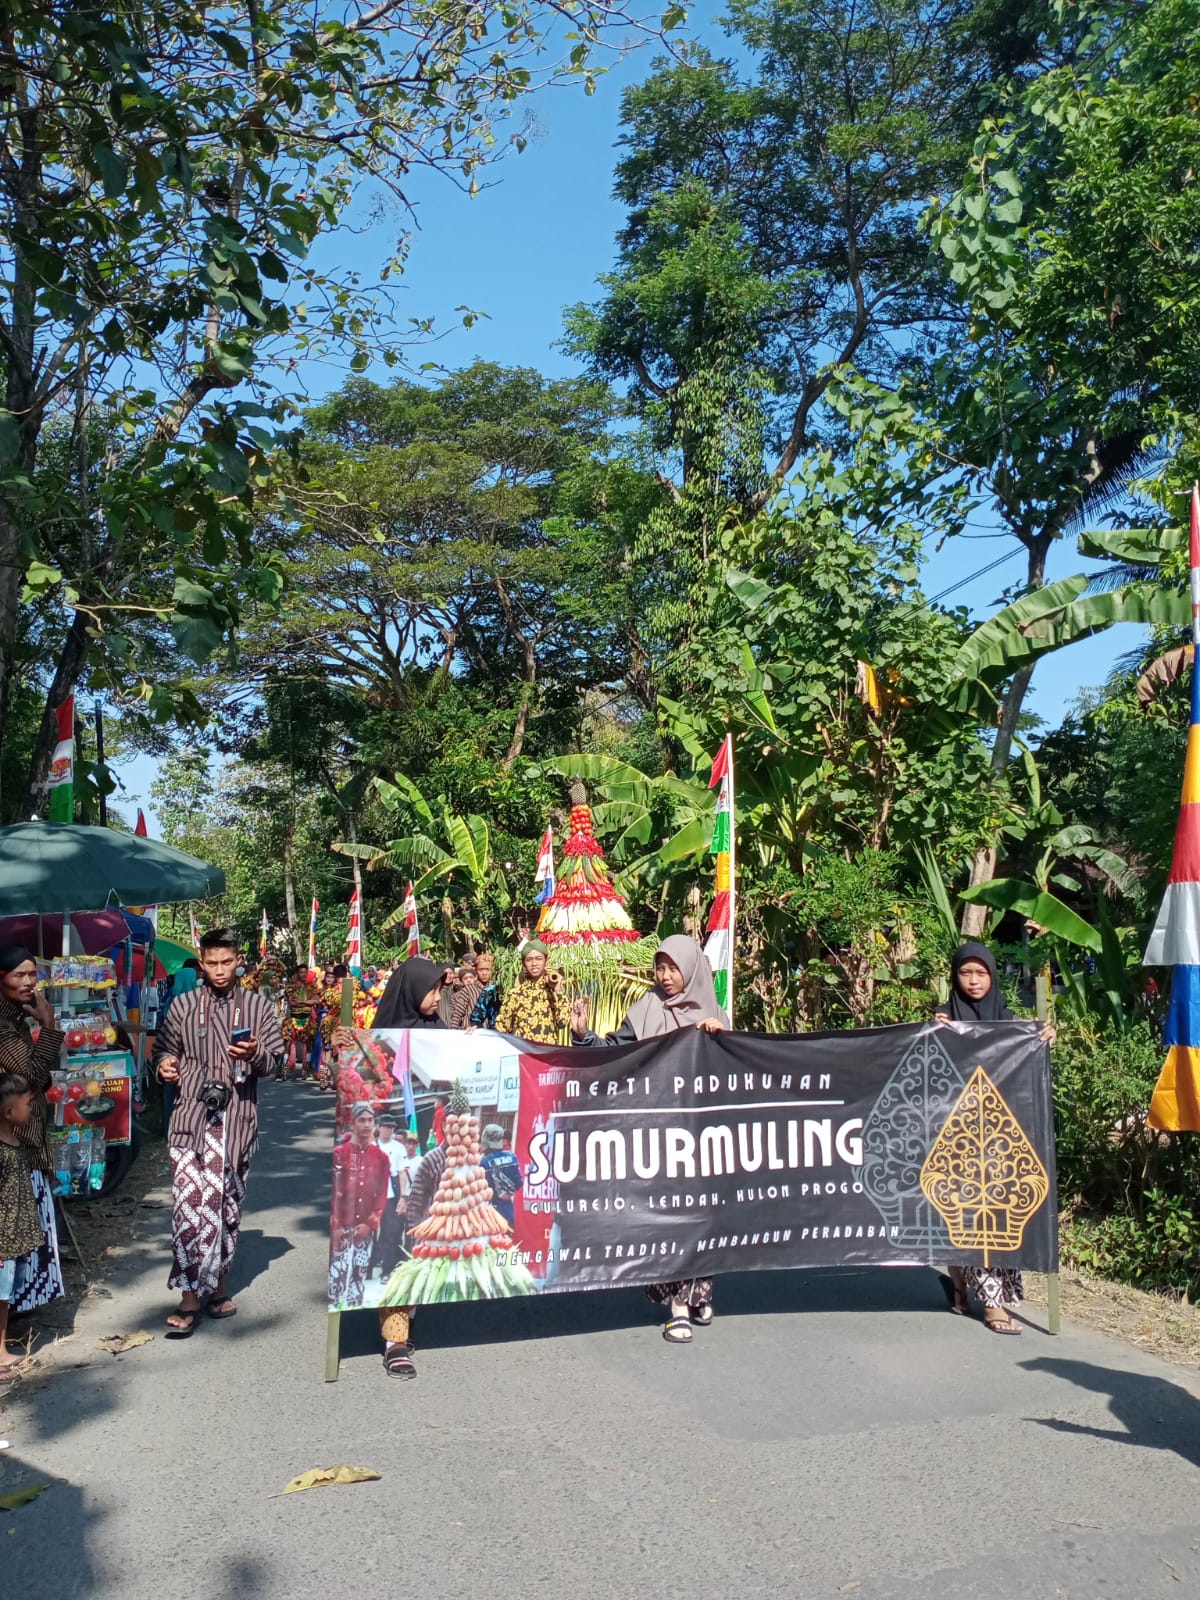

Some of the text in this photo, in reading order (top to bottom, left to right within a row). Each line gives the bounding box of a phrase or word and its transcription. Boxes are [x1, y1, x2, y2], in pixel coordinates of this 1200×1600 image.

[566, 1073, 831, 1097] MERTI PADUKUHAN
[528, 1118, 864, 1186] SUMURMULING
[736, 1185, 790, 1203] KULON
[801, 1182, 864, 1196] PROGO
[496, 1225, 900, 1266] MENGAWAL TRADISI, MEMBANGUN PERADABAN
